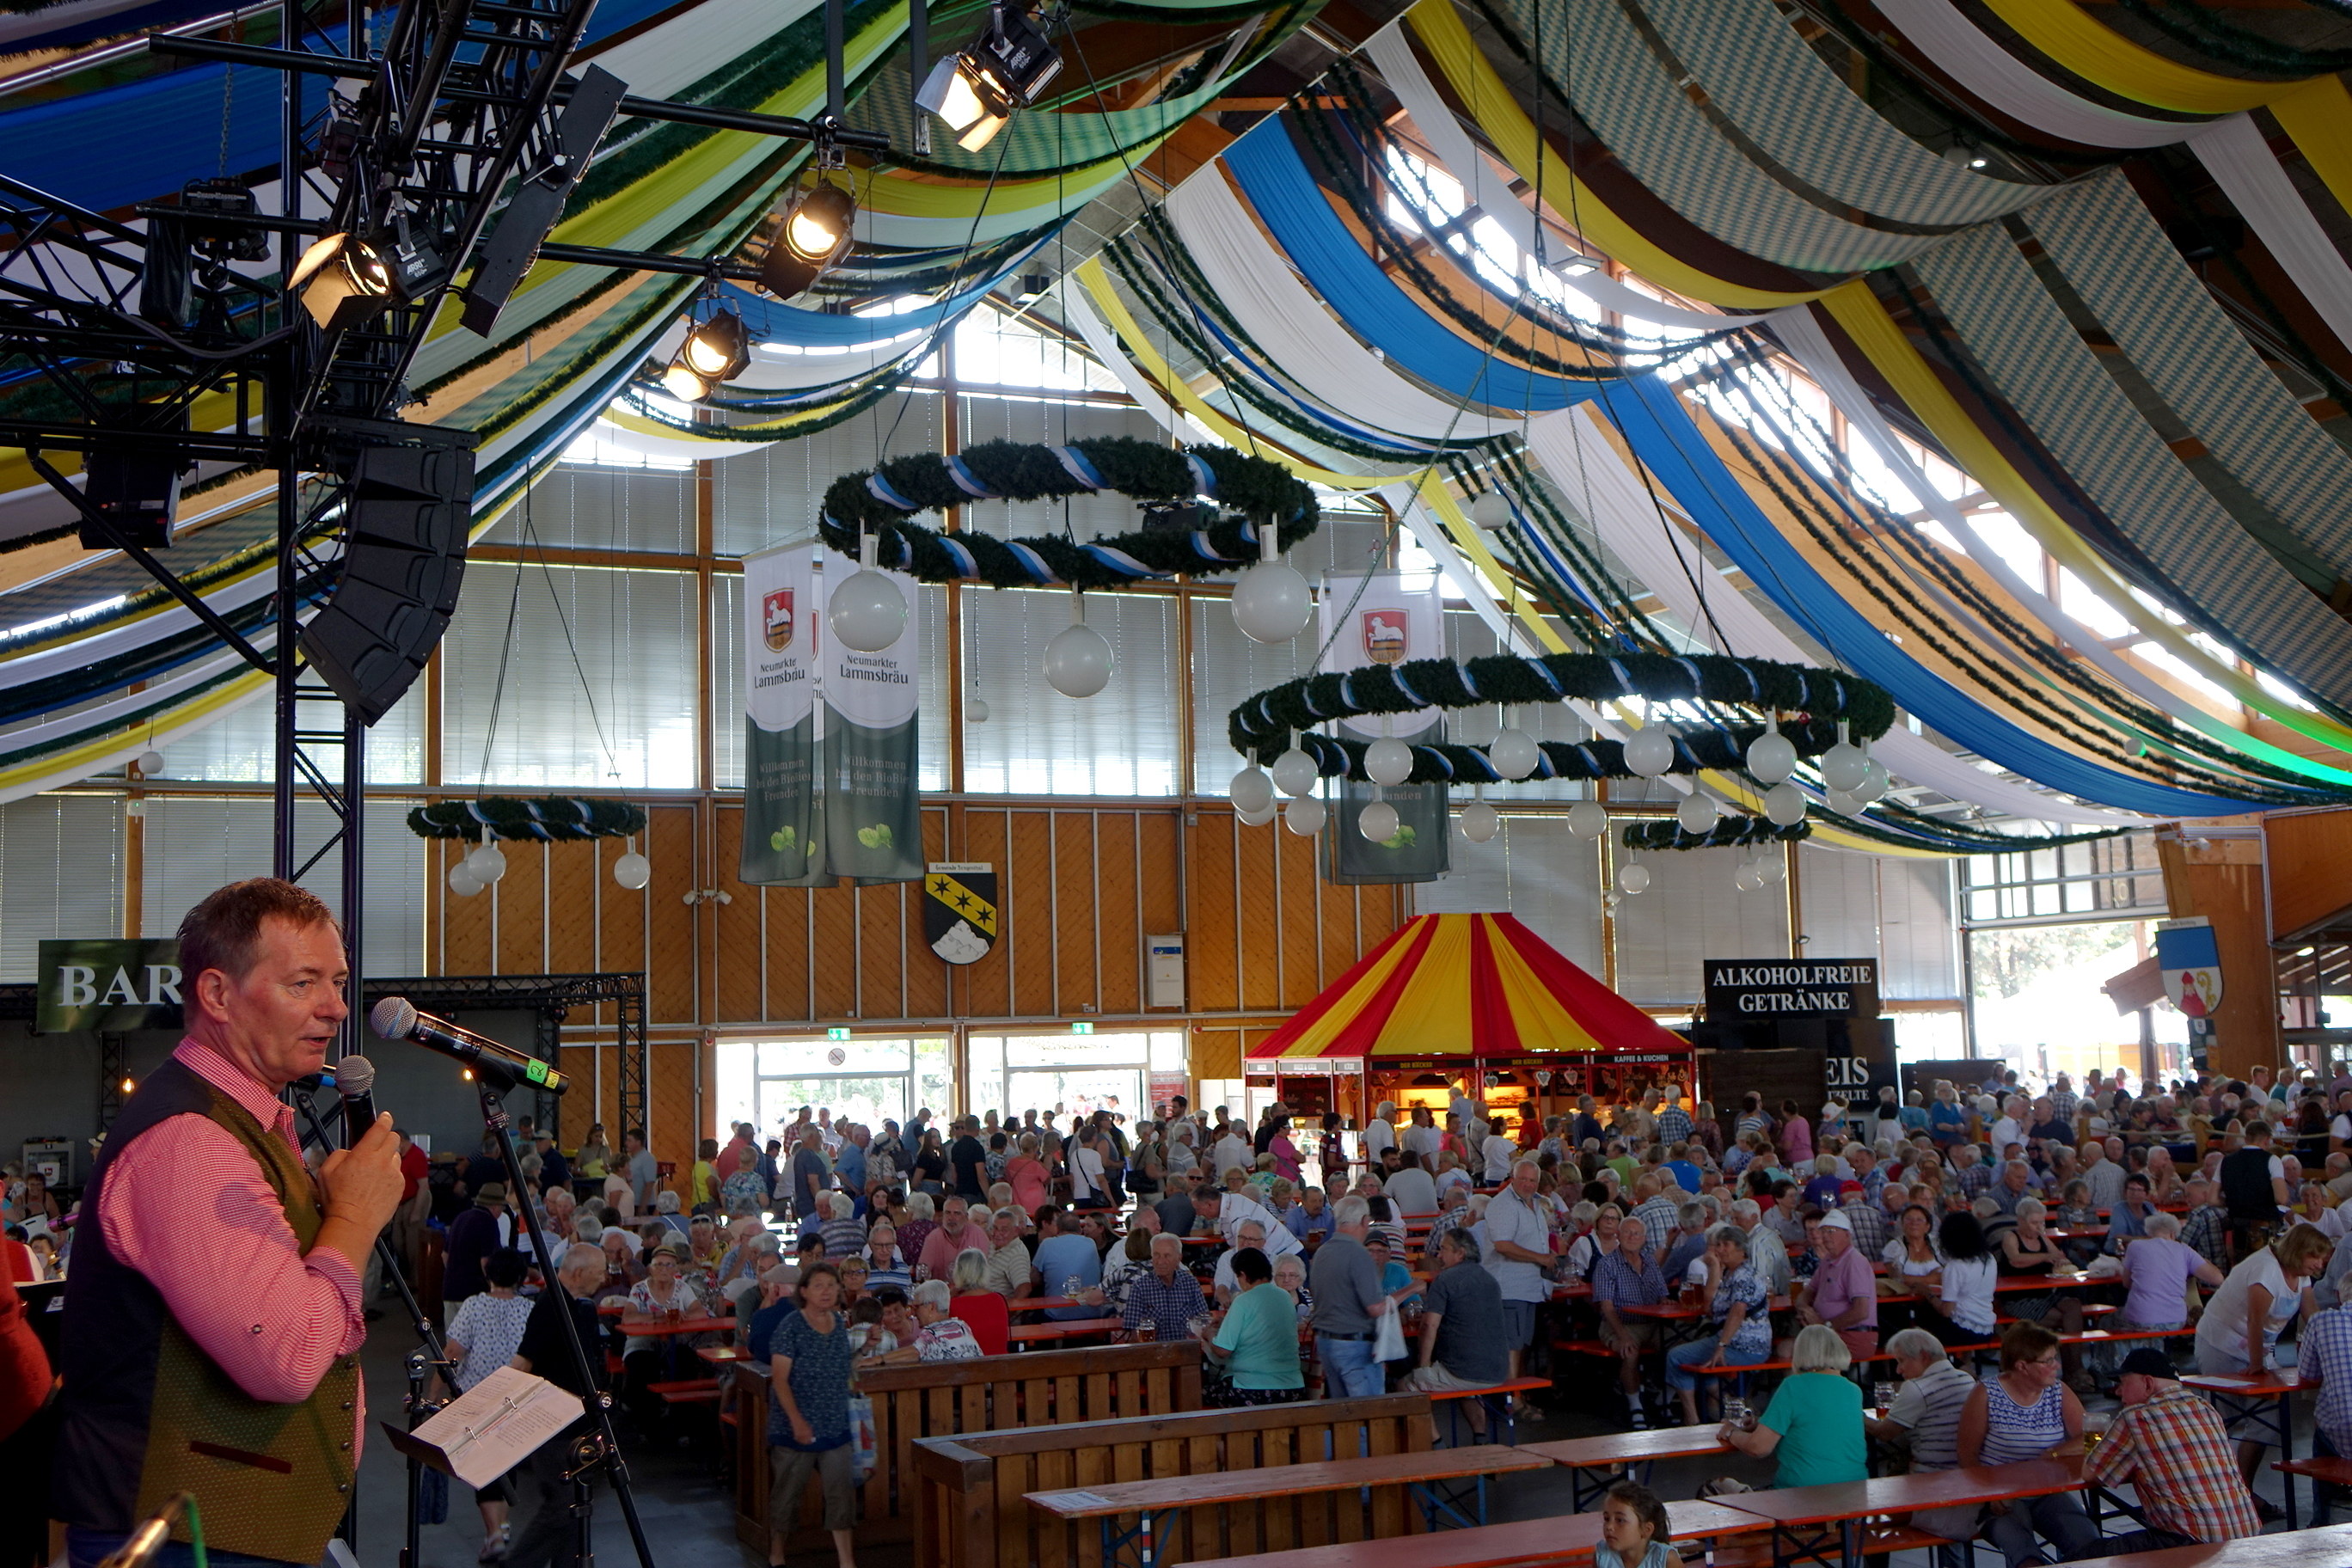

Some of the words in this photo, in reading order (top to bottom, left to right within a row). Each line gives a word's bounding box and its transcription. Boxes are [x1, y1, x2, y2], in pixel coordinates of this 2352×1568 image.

[1011, 50, 1026, 69] ARRI
[407, 259, 425, 275] ARRI
[760, 658, 797, 673] Neumrkte
[847, 654, 898, 669] Neumarkter
[840, 664, 910, 684] Lammsbräu
[843, 755, 906, 770] Willkommen
[853, 771, 873, 782] den
[850, 783, 898, 798] Freunden
[1368, 791, 1422, 801] Funden
[1713, 965, 1872, 987] ALKOHOLFREIE
[58, 965, 184, 1007] BAR
[1739, 989, 1850, 1013] GETRÄNKE
[1643, 1054, 1669, 1063] KUCHEN
[530, 1064, 544, 1077] 2
